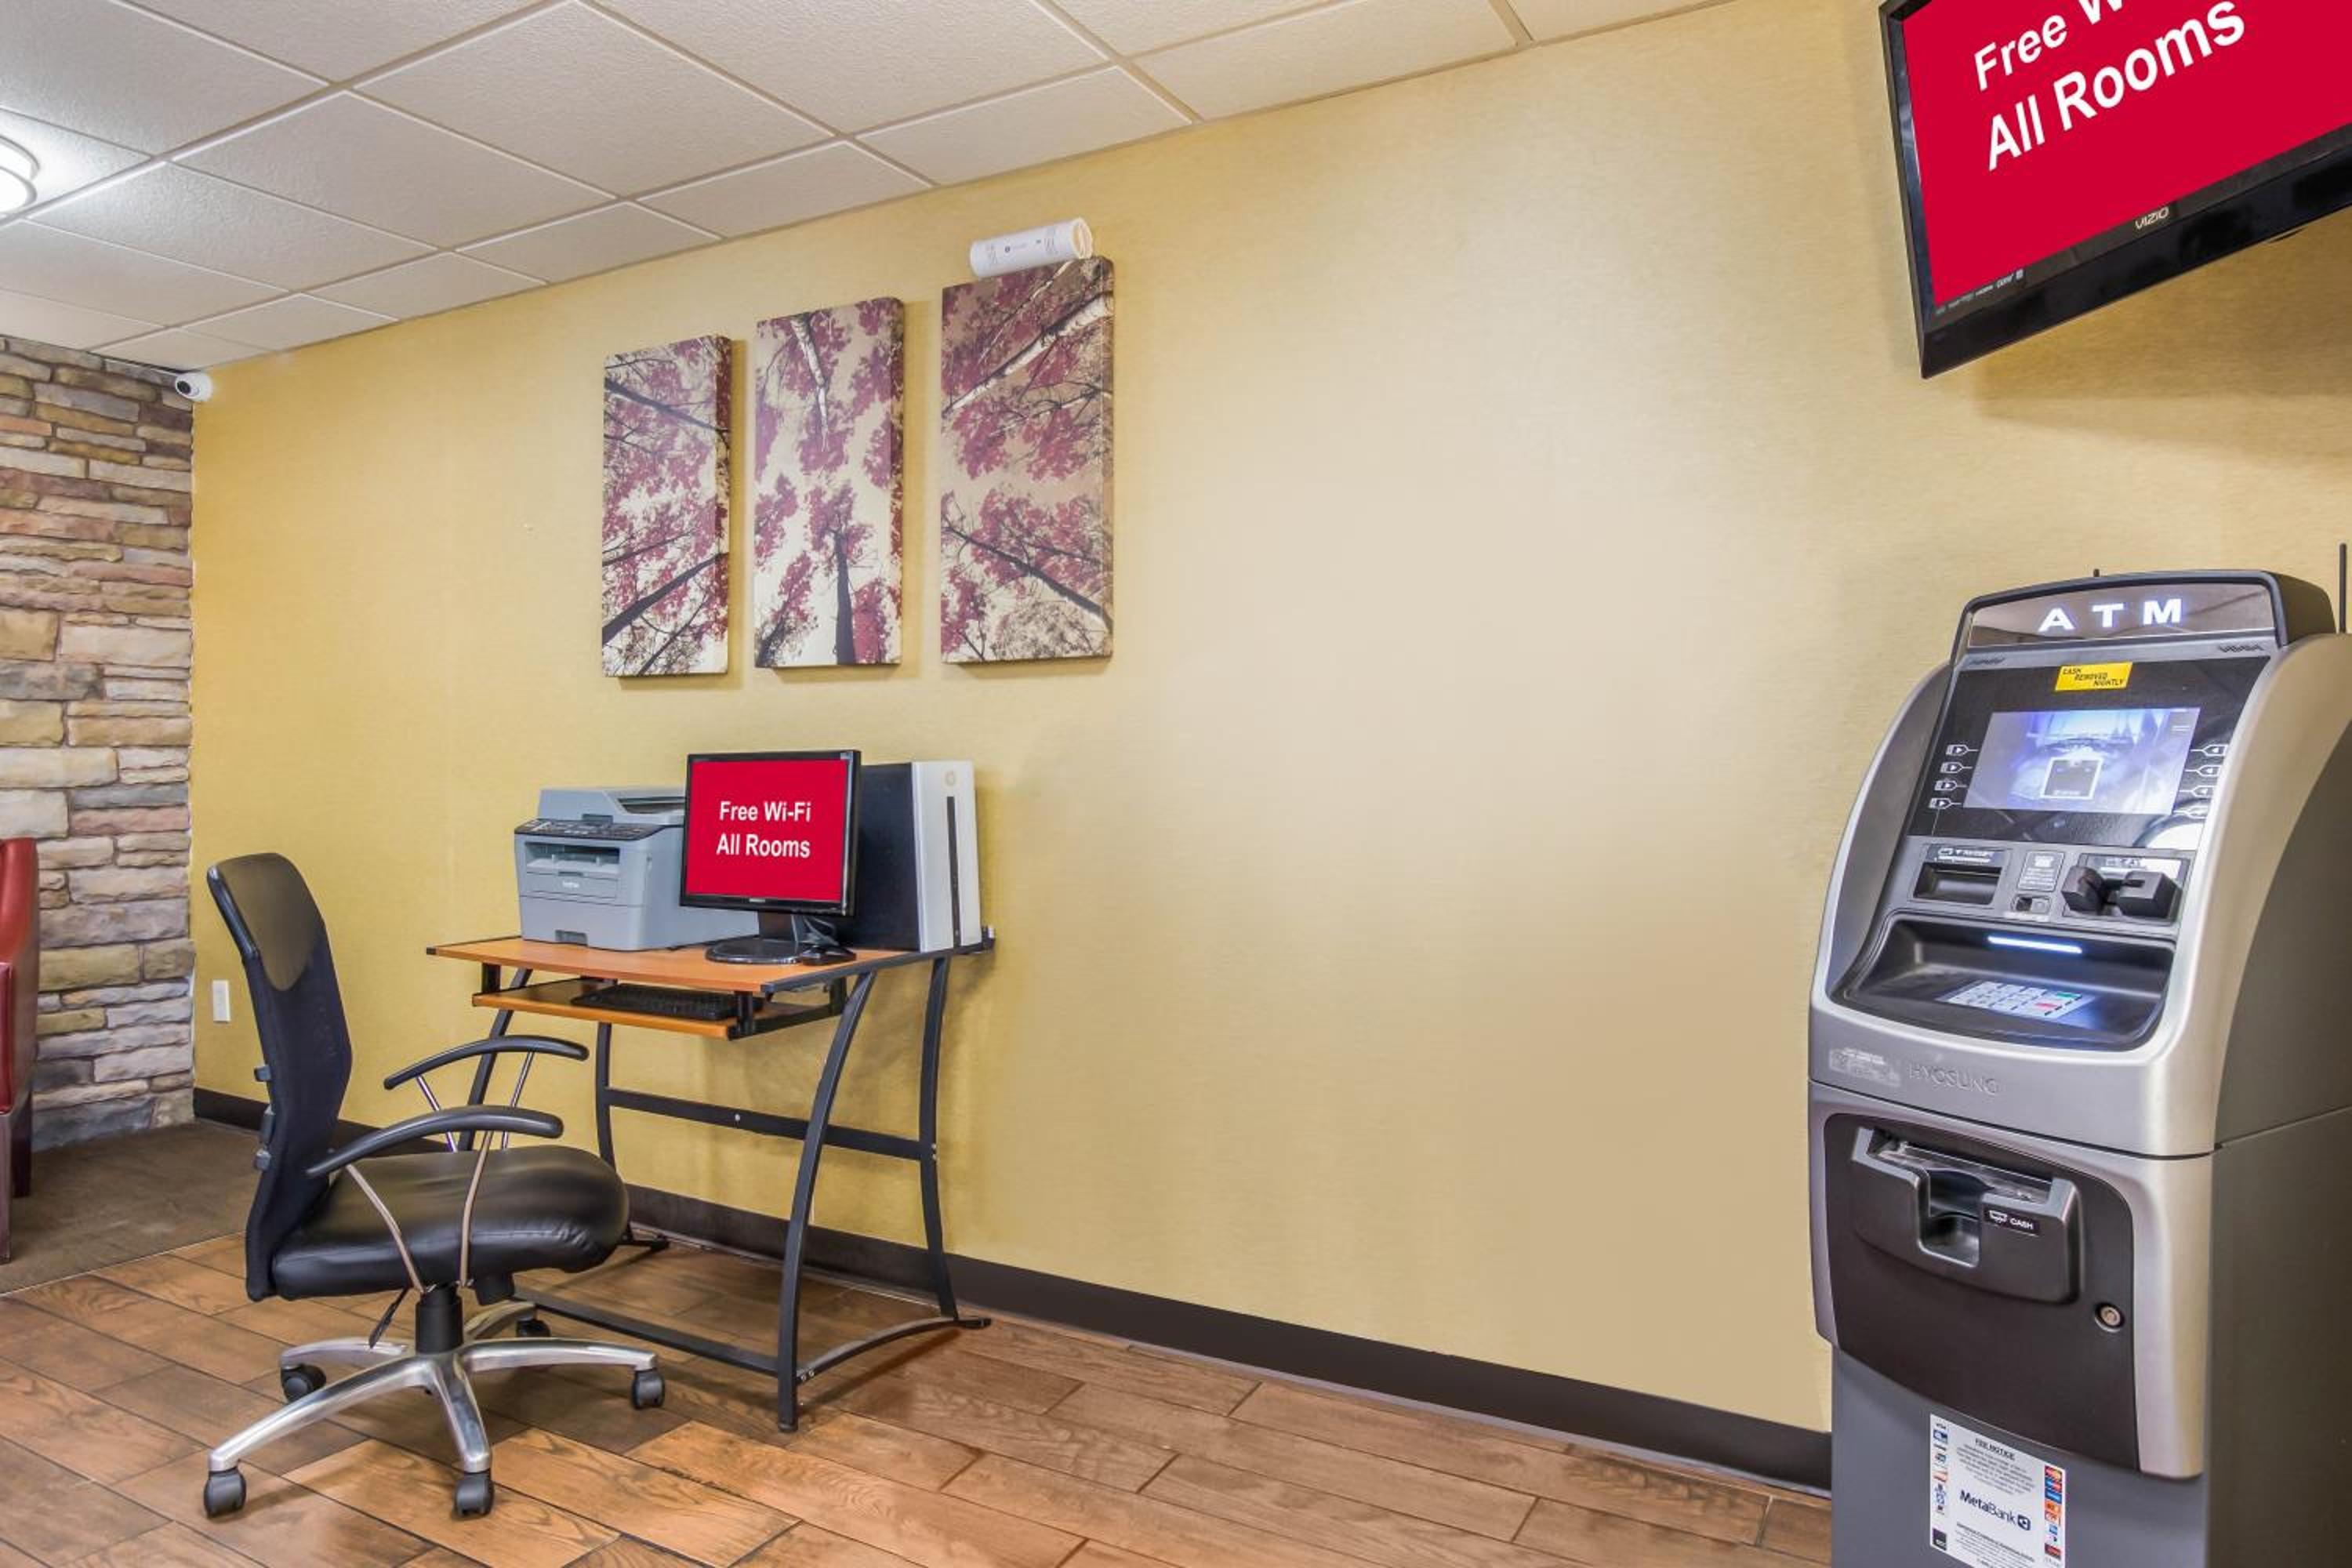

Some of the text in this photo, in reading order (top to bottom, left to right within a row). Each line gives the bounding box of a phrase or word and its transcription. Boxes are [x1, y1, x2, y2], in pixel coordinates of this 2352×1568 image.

[1974, 15, 2067, 92] Free
[1989, 1, 2245, 171] All Rooms
[2135, 206, 2169, 229] VIZIO
[2038, 598, 2182, 632] ATM
[719, 800, 811, 822] Free Wi-Fi
[716, 833, 811, 858] All Rooms
[1908, 1065, 1998, 1096] HYOSUNG
[2009, 1218, 2034, 1230] CASH
[1960, 1490, 2016, 1526] MetaBank
